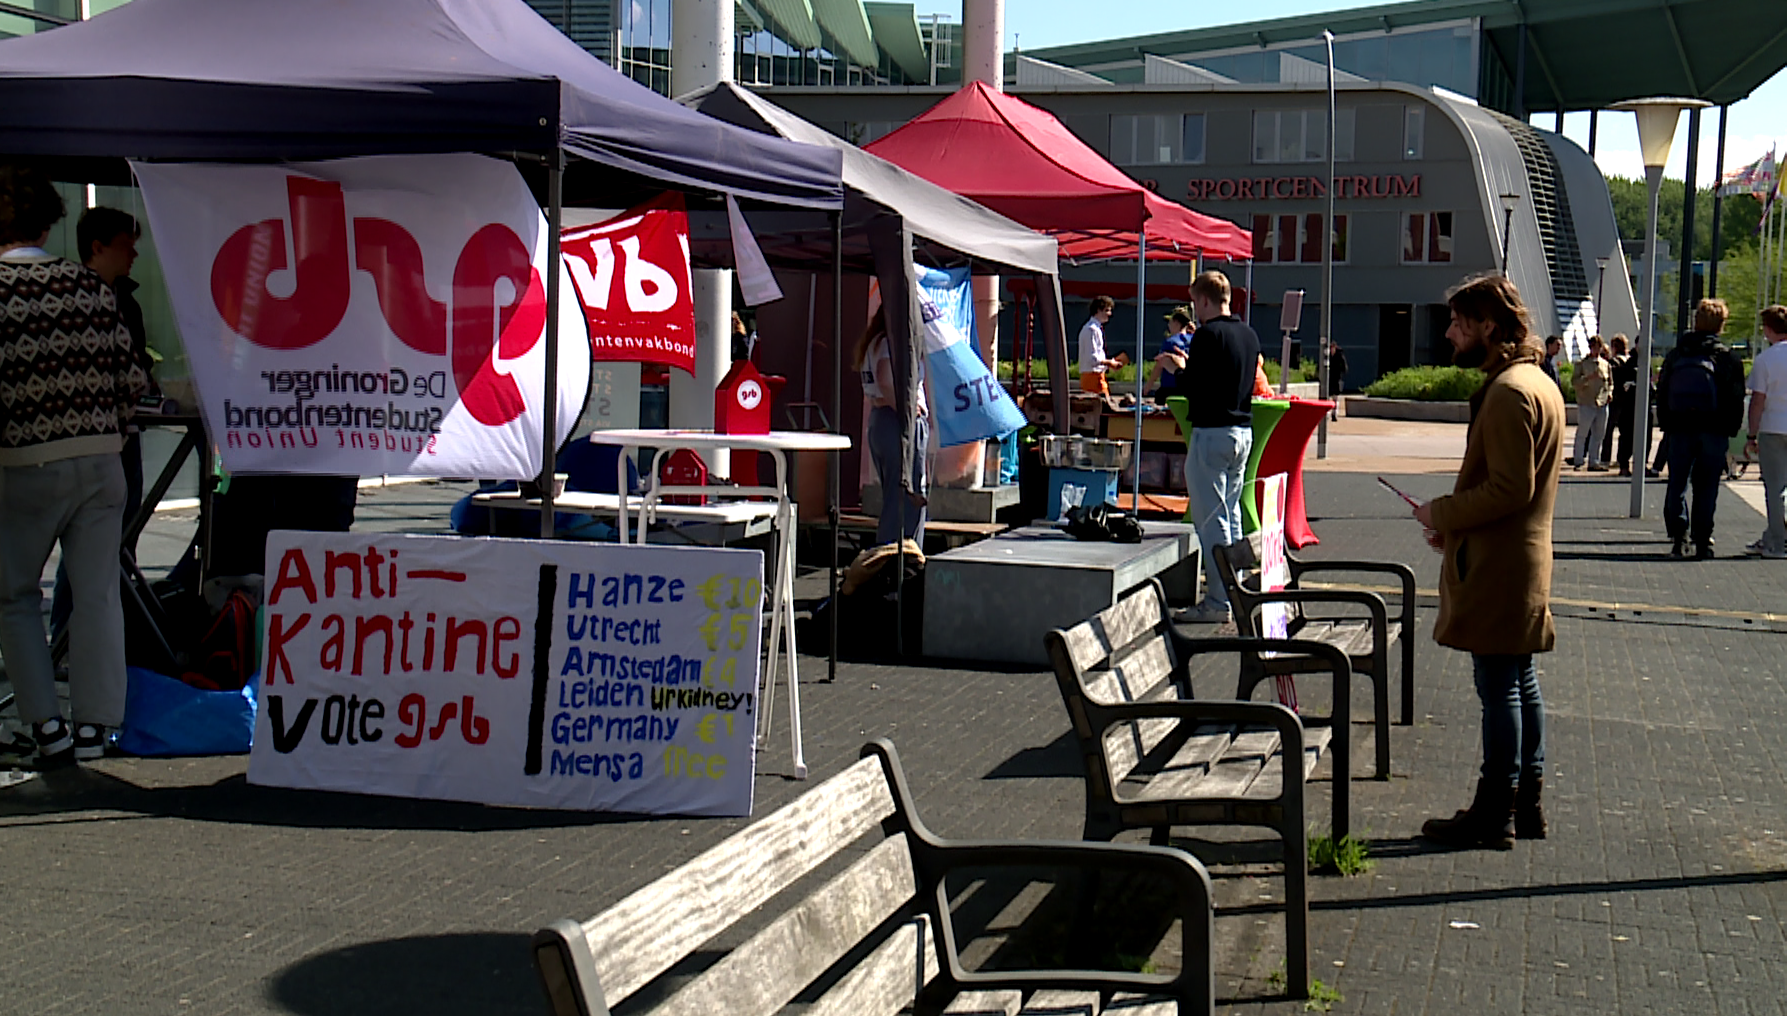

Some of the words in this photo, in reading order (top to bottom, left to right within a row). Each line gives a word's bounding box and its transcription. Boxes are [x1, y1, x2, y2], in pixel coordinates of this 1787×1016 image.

[1186, 174, 1423, 200] SPORTCENTRUM
[590, 335, 695, 358] ntenvakbond
[567, 572, 686, 609] Hanze
[566, 613, 662, 646] Utrecht
[265, 610, 521, 686] Kantine
[558, 677, 645, 709] Leiden
[266, 692, 386, 754] Vote
[394, 692, 490, 749] gsb
[550, 711, 680, 746] Germany
[550, 749, 644, 783] Mensa
[662, 744, 728, 780] free
